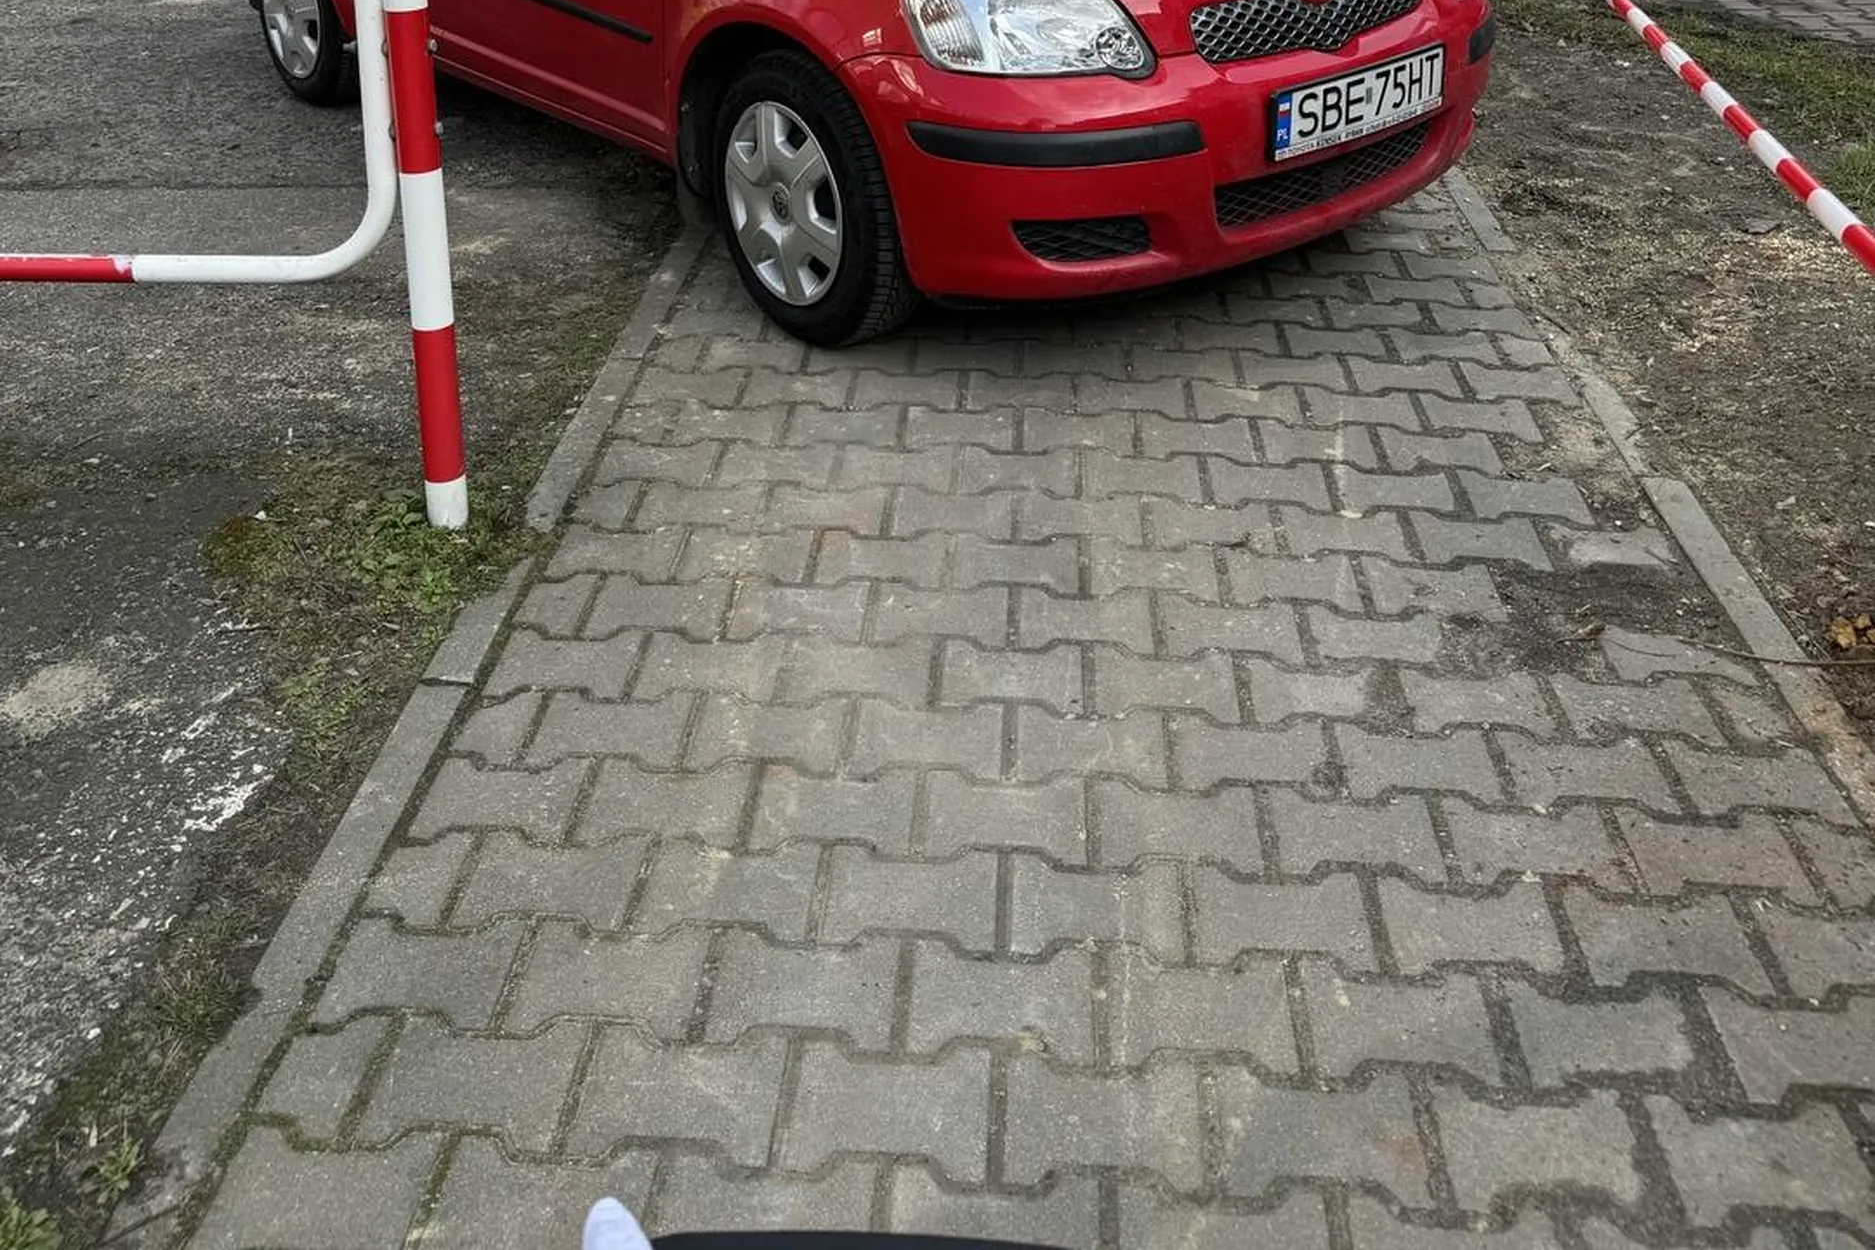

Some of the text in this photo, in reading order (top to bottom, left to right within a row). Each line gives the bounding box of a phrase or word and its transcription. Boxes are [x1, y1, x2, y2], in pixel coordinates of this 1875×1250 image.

[1298, 79, 1364, 137] SBE
[1375, 53, 1440, 116] 75HT
[1277, 128, 1290, 141] PL
